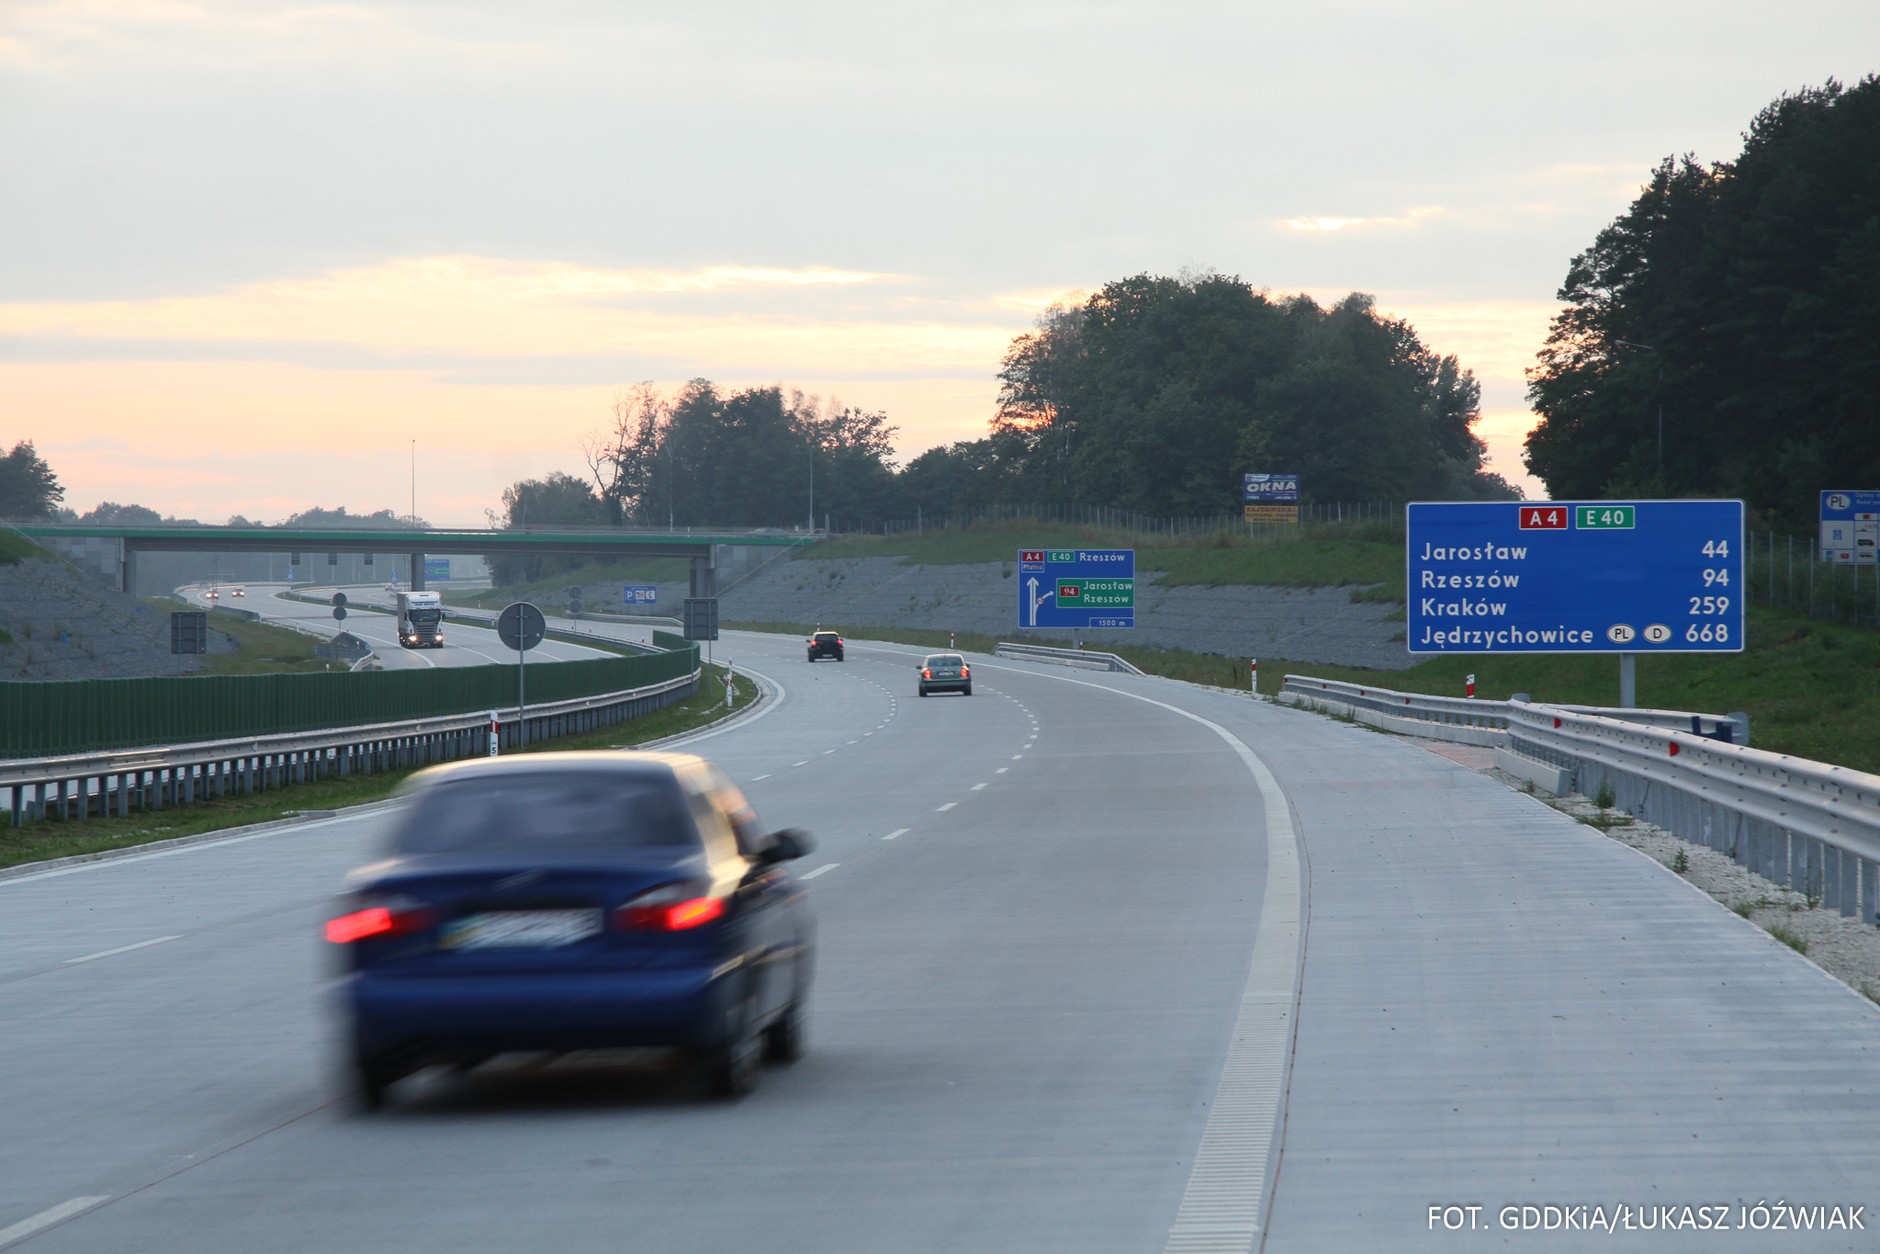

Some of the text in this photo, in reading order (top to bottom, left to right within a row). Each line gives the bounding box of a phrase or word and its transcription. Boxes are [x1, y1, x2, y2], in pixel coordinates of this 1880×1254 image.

[1247, 482, 1296, 493] OKNA
[1830, 496, 1845, 508] PL
[1080, 552, 1125, 561] Rzeszów
[1421, 543, 1527, 560] Jarosław
[1702, 540, 1728, 558] 44
[1083, 581, 1132, 590] Jarosław
[1422, 570, 1519, 588] Rzeszów
[1703, 569, 1728, 587] 94
[1084, 594, 1128, 602] Rzeszów
[1422, 598, 1506, 615] Kraków
[1689, 597, 1729, 615] 259
[1422, 624, 1728, 648] Jędrzychowice PL D 668
